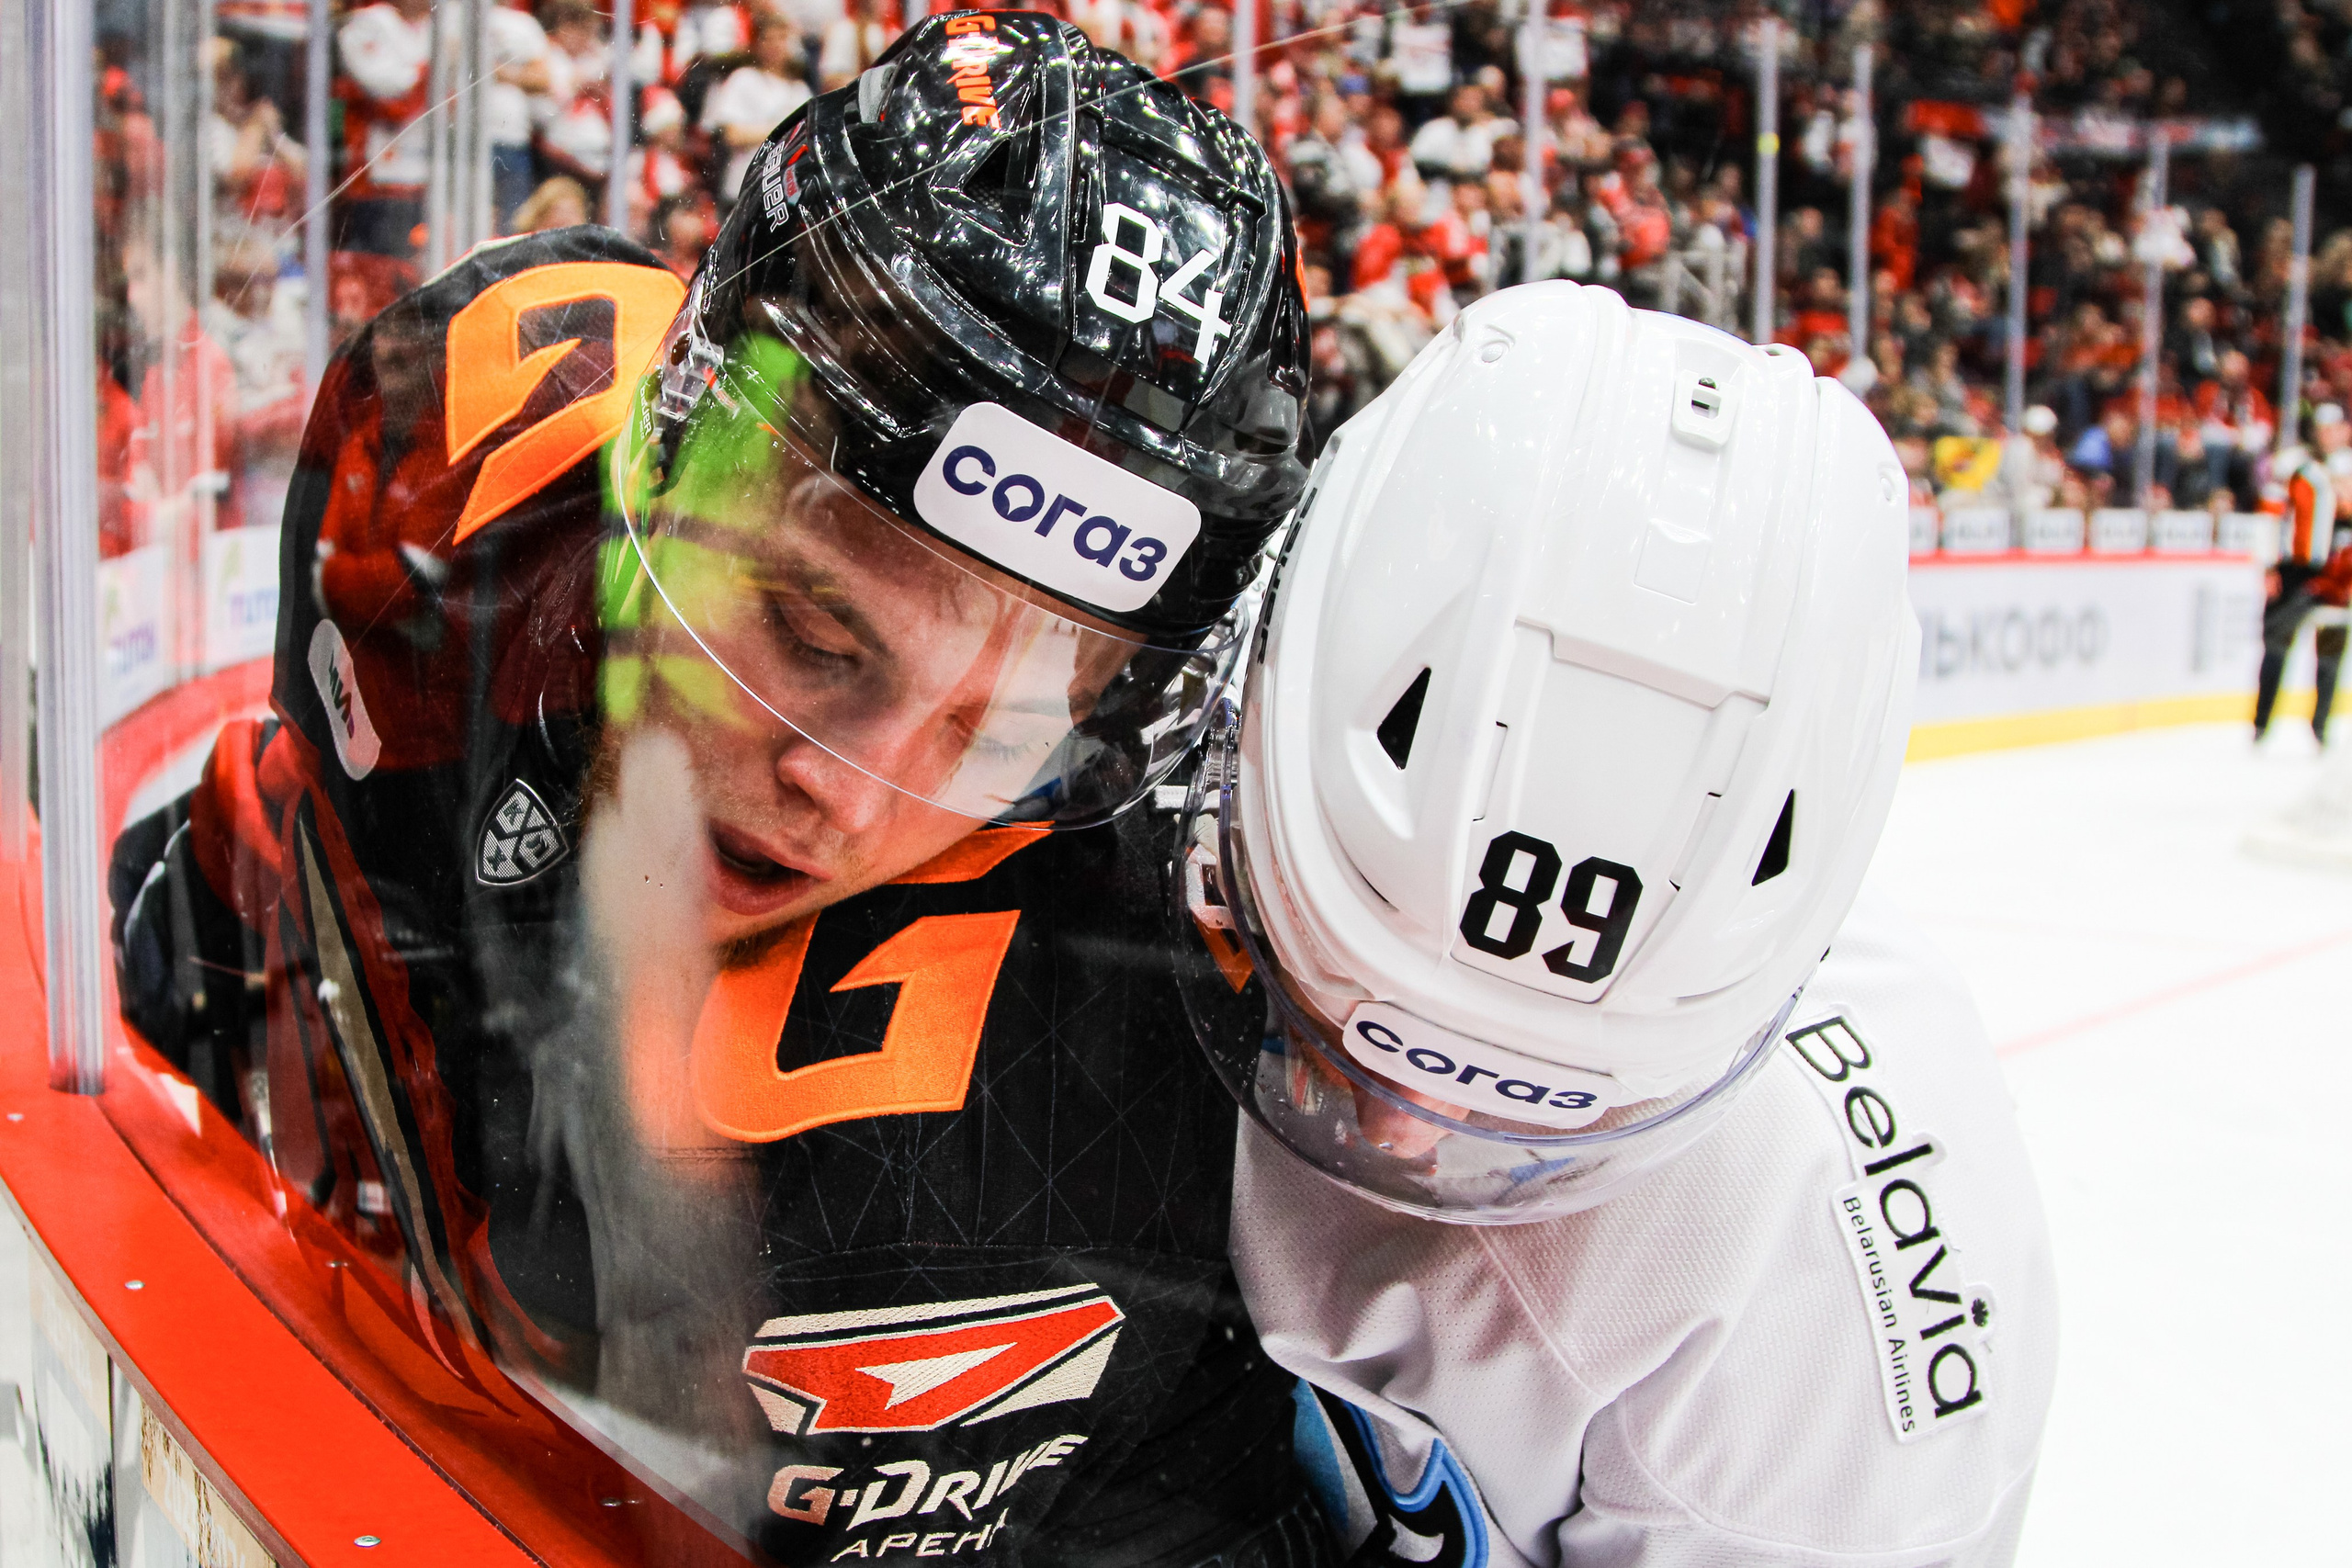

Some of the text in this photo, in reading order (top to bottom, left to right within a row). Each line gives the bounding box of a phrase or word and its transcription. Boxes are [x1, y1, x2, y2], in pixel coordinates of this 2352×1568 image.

[1084, 201, 1233, 367] 84
[942, 444, 1169, 582] согаз
[1458, 829, 1645, 985] 89
[1355, 1020, 1599, 1110] согаз
[1785, 1015, 1989, 1419] Belavia
[1842, 1196, 1916, 1433] Belarusian Airlines
